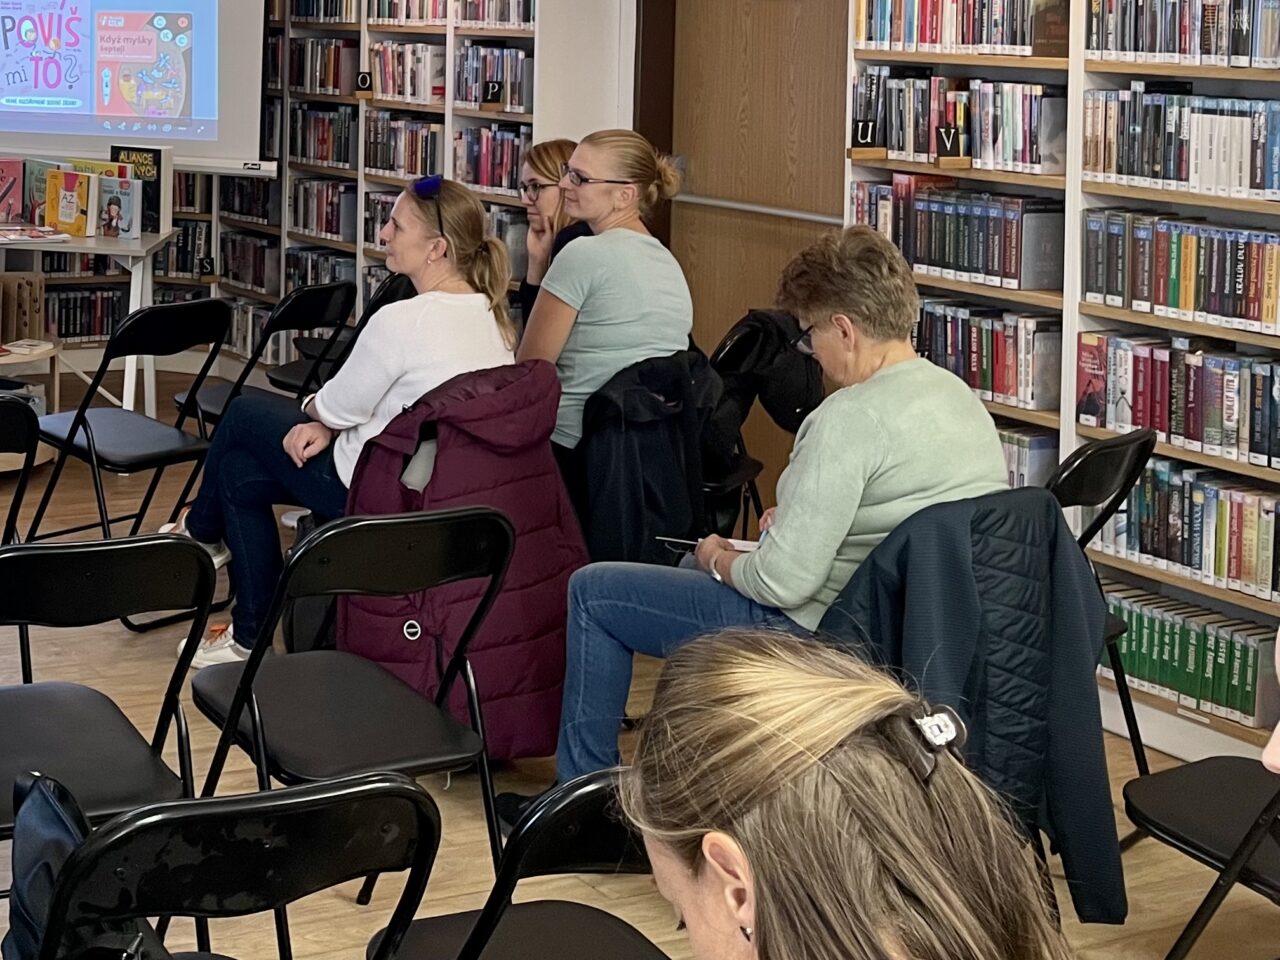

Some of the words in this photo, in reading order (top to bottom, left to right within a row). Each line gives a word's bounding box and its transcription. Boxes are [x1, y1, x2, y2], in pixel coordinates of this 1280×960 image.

[100, 35, 122, 45] Když
[123, 36, 153, 46] myšky
[5, 65, 28, 86] mi
[488, 83, 499, 100] P
[858, 122, 874, 143] U
[939, 128, 955, 151] V
[119, 150, 154, 164] ALIANCE
[1237, 241, 1245, 260] DLU
[203, 258, 211, 273] S
[1235, 261, 1244, 295] KRÁLŮV
[1192, 532, 1201, 568] VIRGINIA
